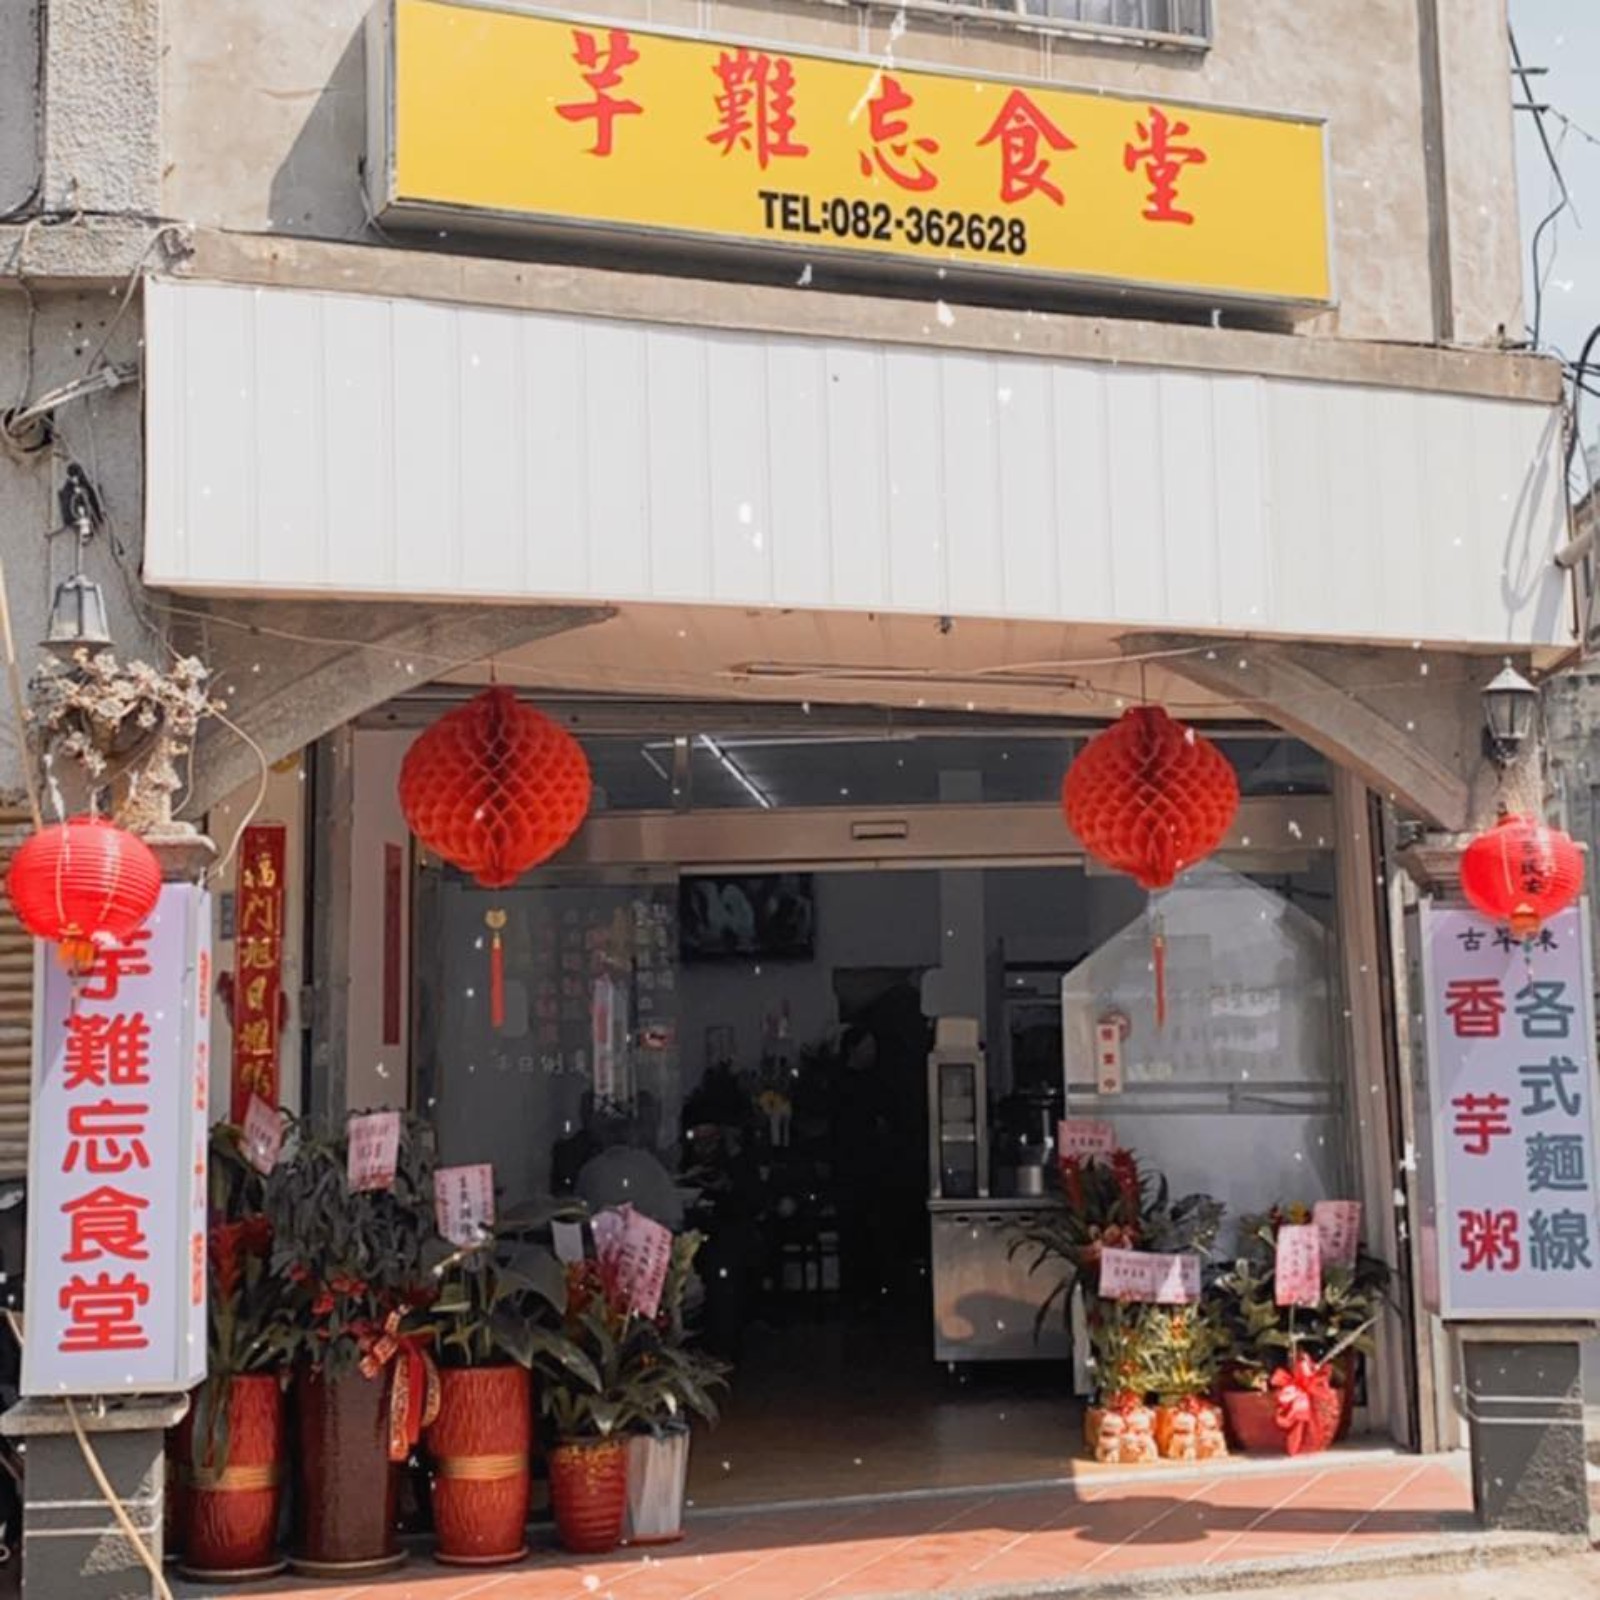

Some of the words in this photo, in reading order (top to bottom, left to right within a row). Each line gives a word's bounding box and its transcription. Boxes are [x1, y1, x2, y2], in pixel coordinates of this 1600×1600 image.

[555, 28, 1207, 225] 芋難忘食堂
[57, 924, 153, 1354] 芋難忘食堂
[1445, 978, 1521, 1272] 香芋粥
[1514, 980, 1593, 1272] 各式麵線
